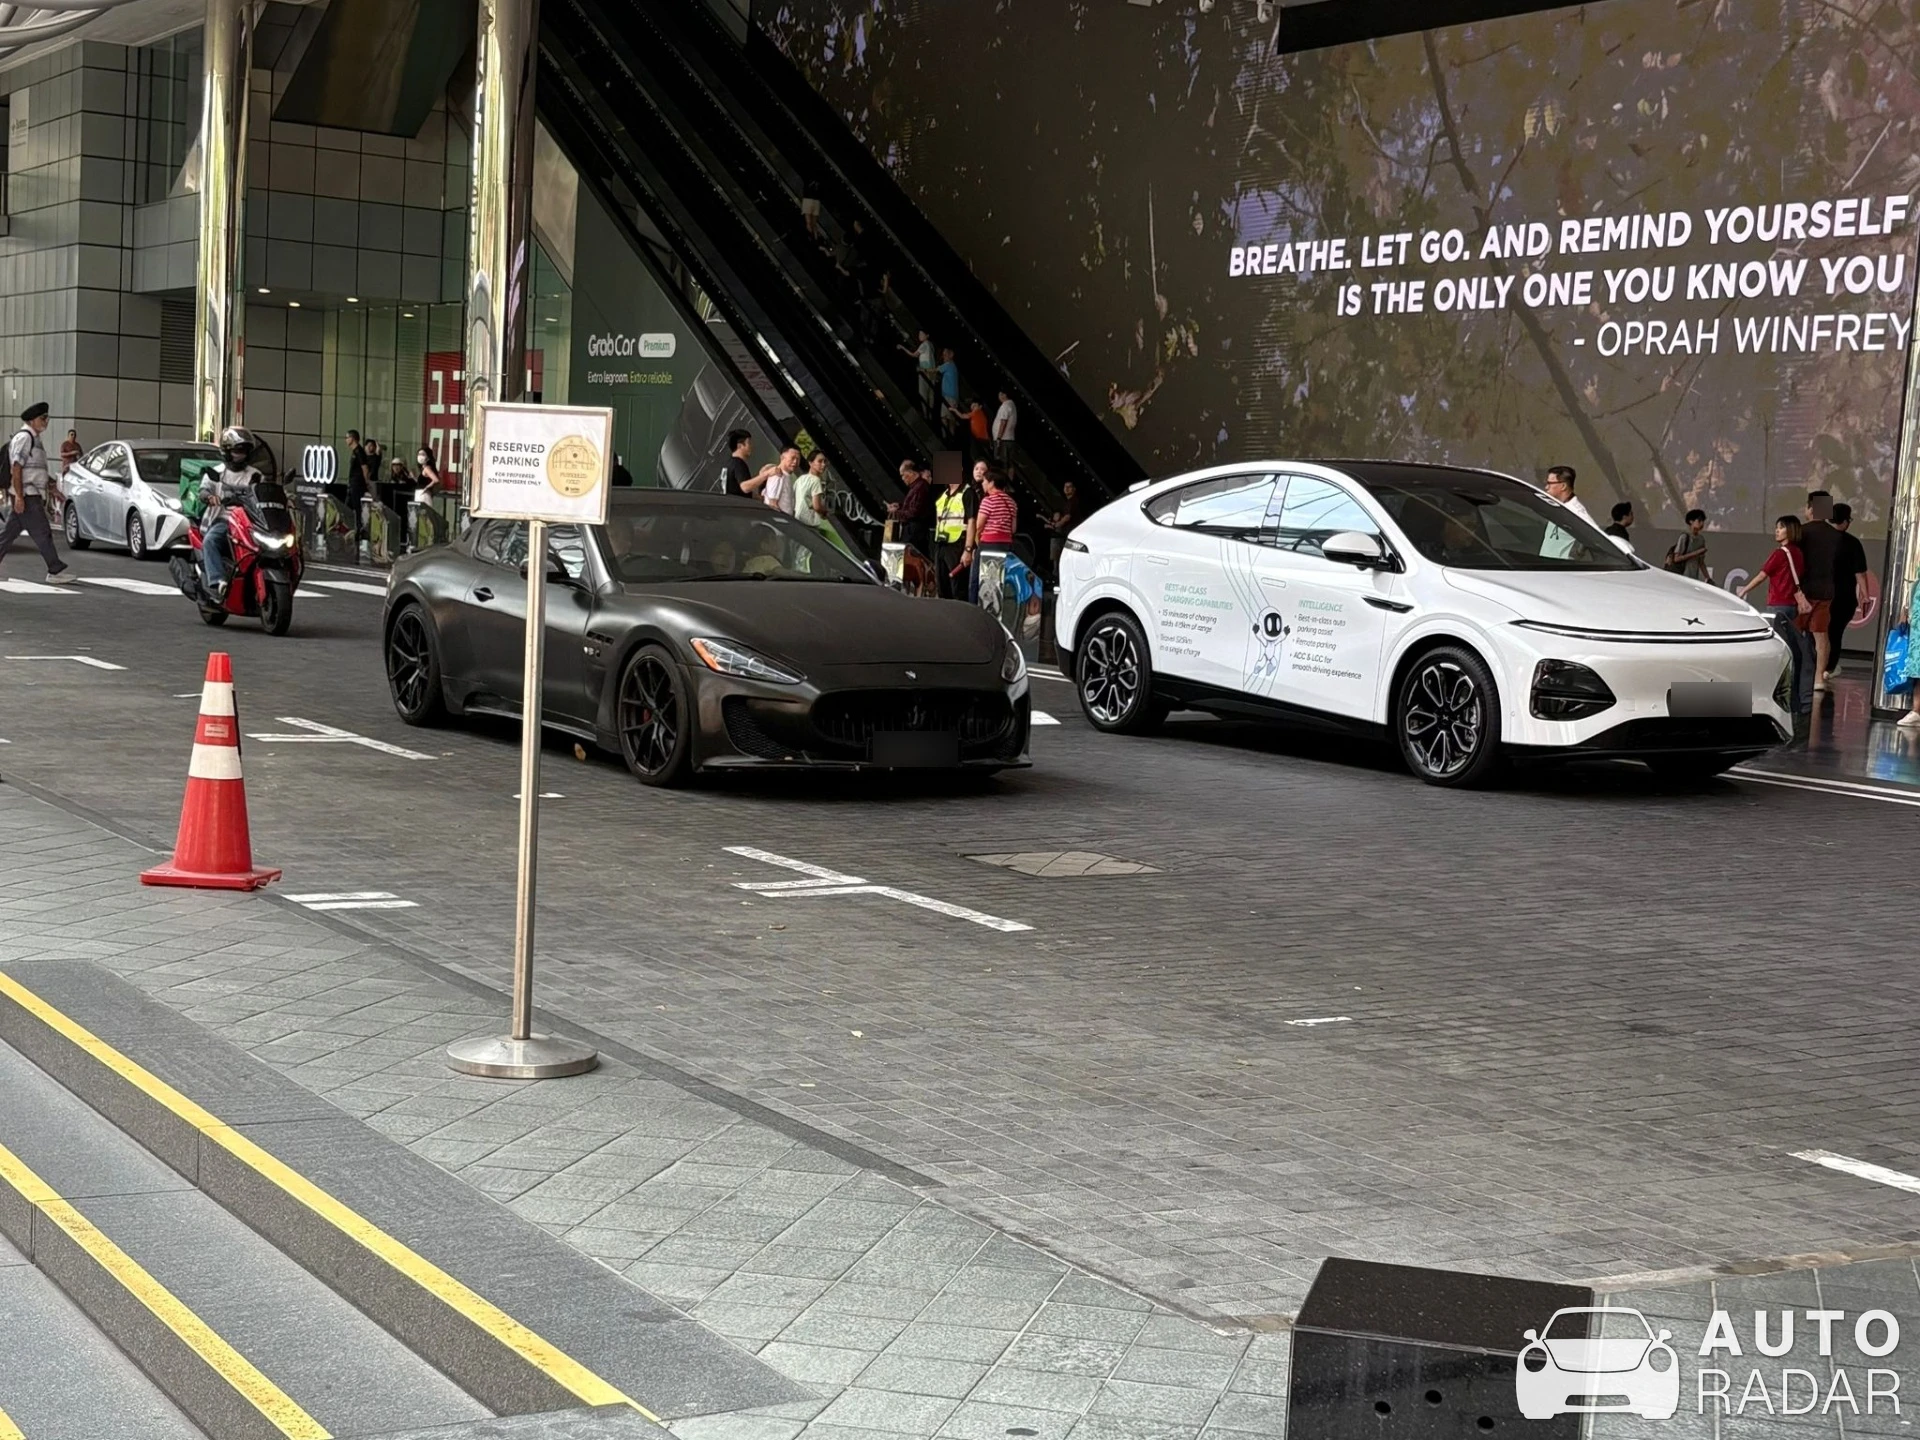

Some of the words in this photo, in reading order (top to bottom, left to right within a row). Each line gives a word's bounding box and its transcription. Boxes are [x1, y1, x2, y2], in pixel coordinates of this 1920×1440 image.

[1229, 238, 1352, 277] BREATHE.
[1360, 233, 1412, 267] LET
[1419, 229, 1470, 264] GO.
[1479, 222, 1549, 259] AND
[1559, 212, 1692, 254] REMIND
[1704, 195, 1909, 244] YOURSELF
[1336, 285, 1361, 316] IS
[1370, 280, 1425, 314] THE
[1433, 275, 1515, 312] ONLY
[1523, 271, 1594, 308] ONE
[1603, 266, 1675, 303] YOU
[1686, 258, 1808, 300] KNOW
[1819, 254, 1905, 295] YOU
[1597, 318, 1719, 357] OPRAH
[1733, 313, 1911, 353] WINFREY
[588, 332, 636, 356] GrabCar
[643, 340, 670, 352] Premium
[588, 371, 603, 384] Extra
[630, 371, 647, 384] Extra
[490, 441, 545, 453] RESERVED
[492, 455, 540, 467] PARKING
[1164, 594, 1195, 606] CHARGING
[1195, 598, 1234, 610] CAPABILITIES
[1298, 599, 1344, 612] INTELLIGENCE
[1168, 611, 1188, 619] minutes
[1195, 614, 1217, 624] charging
[1298, 613, 1332, 625] Best-in-class
[1297, 625, 1317, 635] parking
[1318, 628, 1334, 636] assist
[1296, 637, 1316, 647] Remote
[1316, 641, 1337, 651] parking
[1293, 652, 1306, 661] ACC
[1312, 655, 1323, 663] LCC
[1324, 656, 1333, 664] for
[1292, 663, 1312, 671] smooth
[1312, 665, 1331, 677] driving
[1331, 669, 1362, 680] experience
